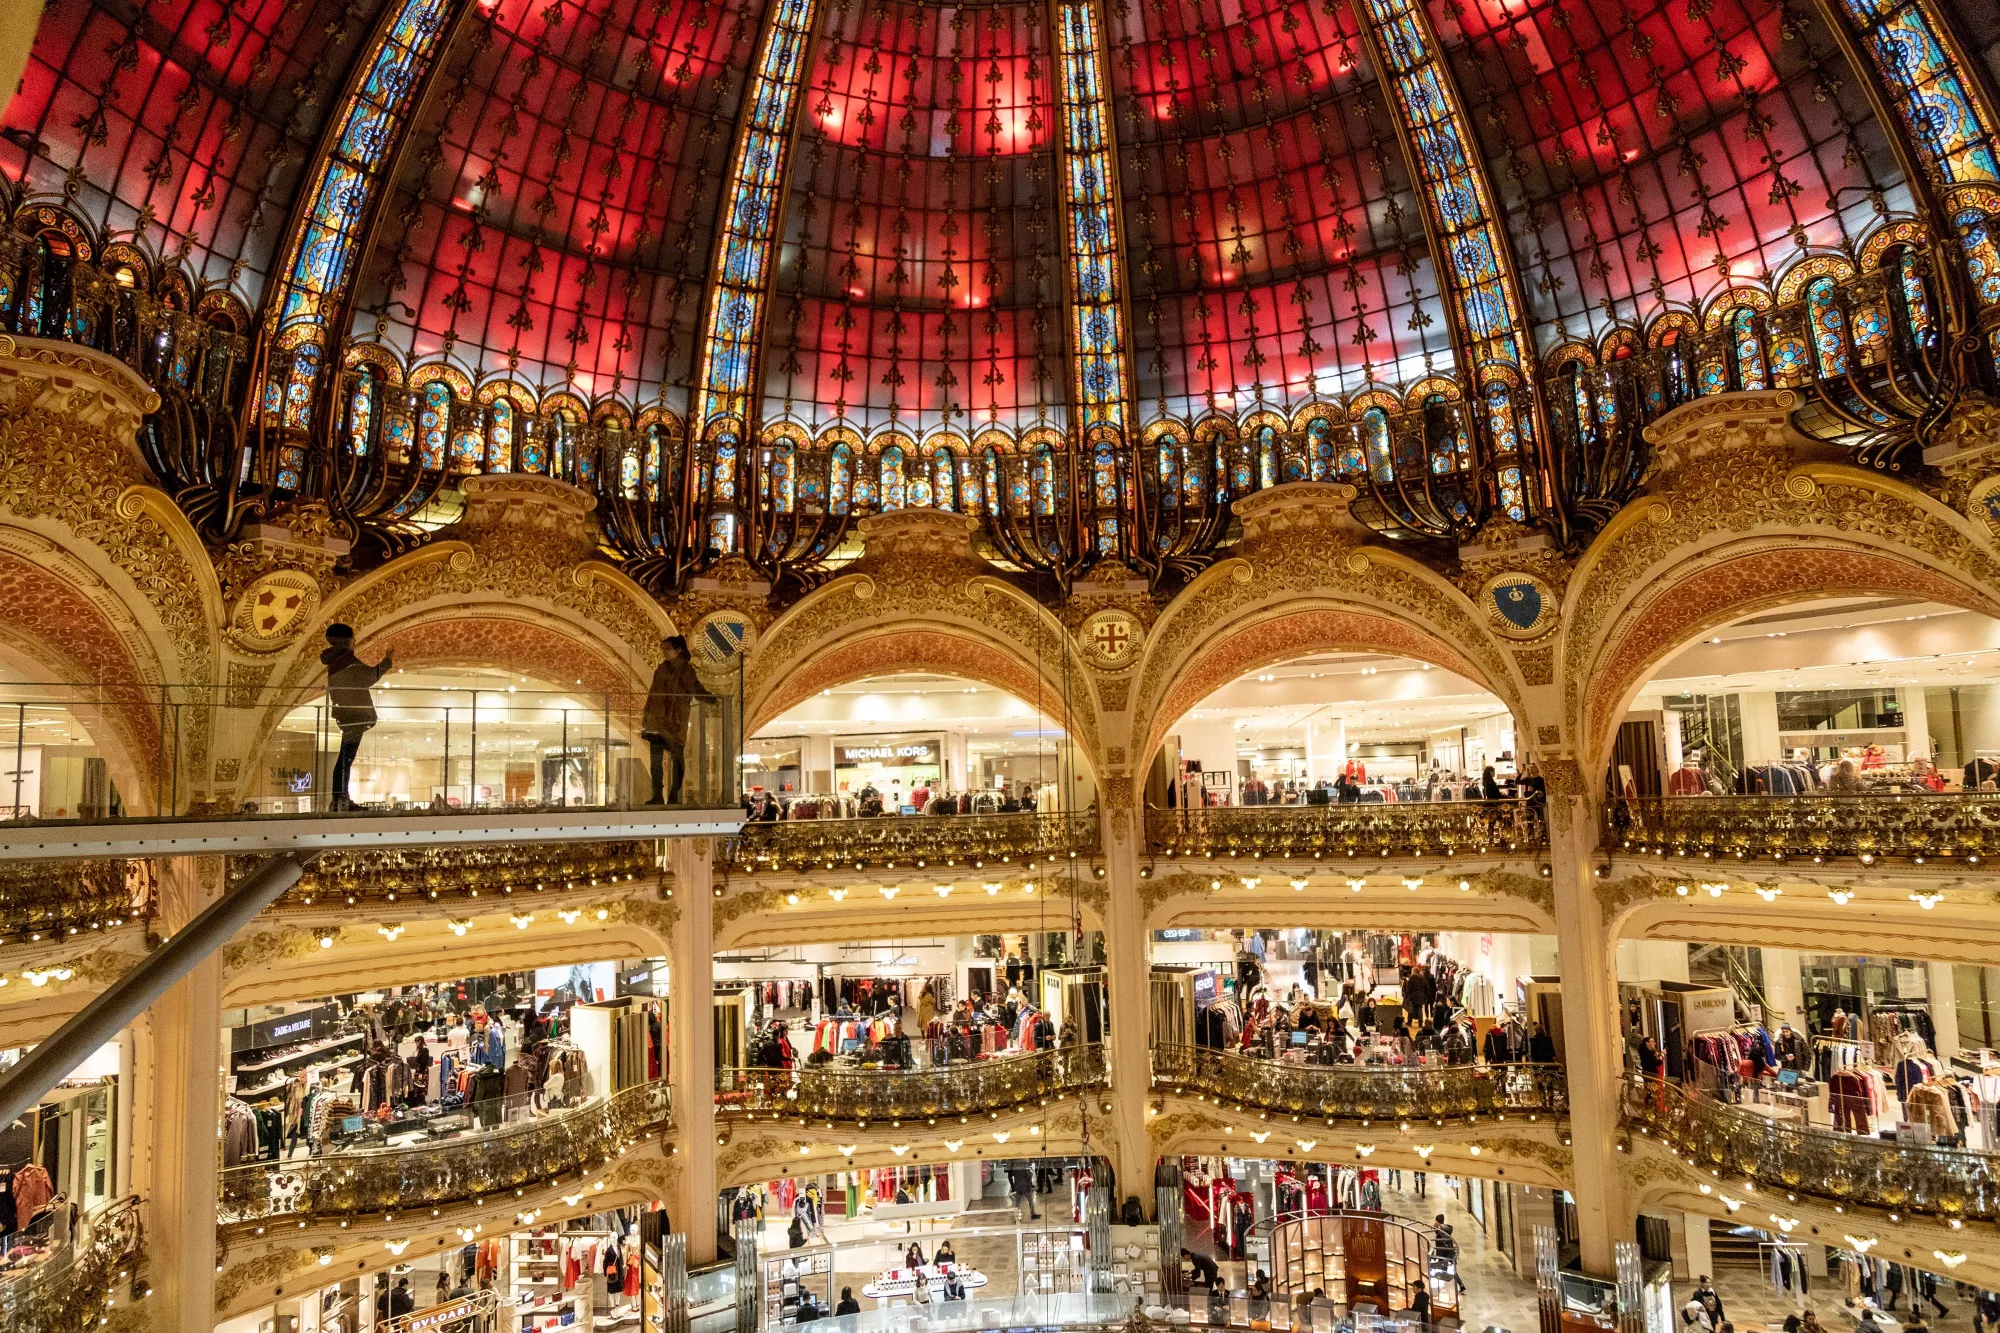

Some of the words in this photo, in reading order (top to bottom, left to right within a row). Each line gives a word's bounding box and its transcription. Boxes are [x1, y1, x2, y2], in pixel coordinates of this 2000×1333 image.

[845, 747, 894, 759] MICHAEL
[897, 746, 928, 757] KORS
[412, 1304, 471, 1331] BVLGARI
